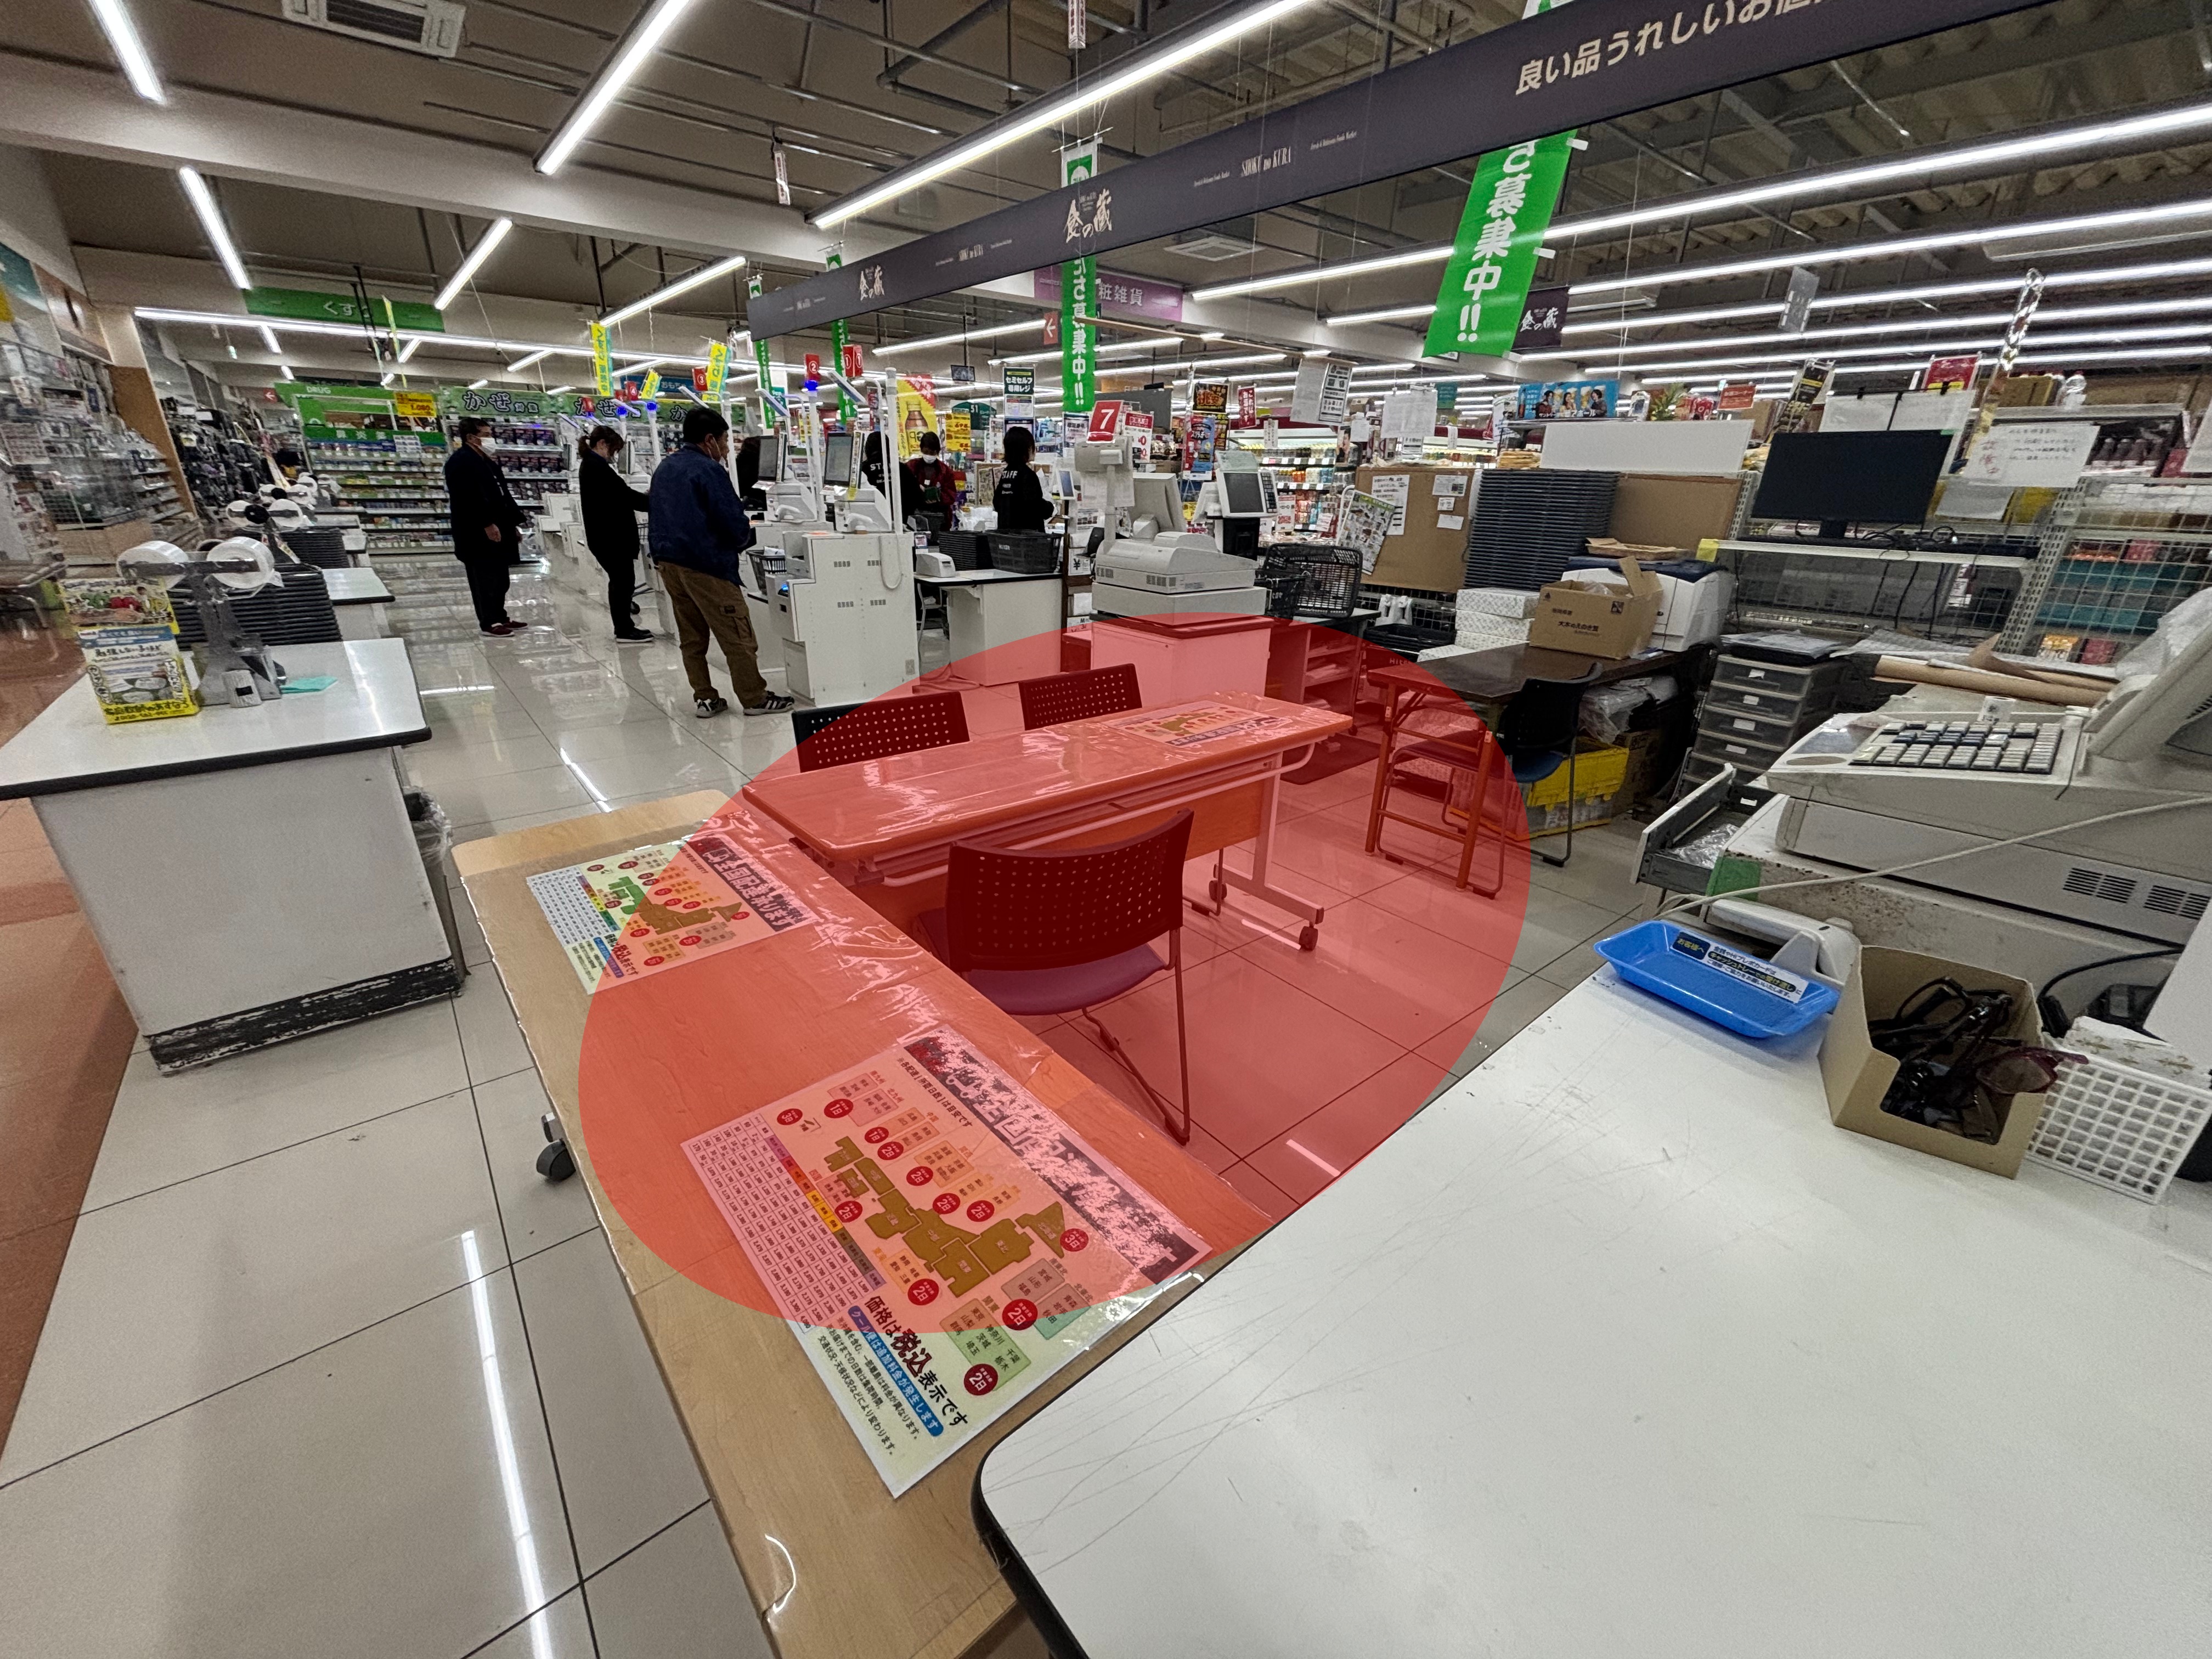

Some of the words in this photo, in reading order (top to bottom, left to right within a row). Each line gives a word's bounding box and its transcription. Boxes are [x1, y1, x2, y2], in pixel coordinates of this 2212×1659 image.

[306, 386, 331, 394] DRUG
[462, 390, 511, 412] かぜ
[1100, 409, 1115, 430] 7
[1002, 470, 1018, 479] STAFF
[712, 859, 805, 929] 全国配達承ります
[1676, 936, 1706, 955] お客様へ
[885, 1087, 905, 1103] 北九州
[828, 1103, 845, 1115] 1日
[780, 1112, 795, 1123] 3日
[867, 1131, 882, 1142] 1日
[880, 1146, 896, 1158] 2日
[910, 1170, 926, 1183] 2日
[837, 1205, 854, 1220] 2日
[935, 1198, 952, 1212] 2日
[969, 1205, 988, 1220] 2日
[1036, 1221, 1057, 1240] 北海道
[1063, 1233, 1082, 1249] 3日
[1027, 1275, 1043, 1290] 山形
[1037, 1268, 1053, 1283] 宮城
[911, 1285, 930, 1302] 2日
[1017, 1282, 1032, 1296] 福島
[1073, 1282, 1095, 1303] 北東北
[981, 1295, 1001, 1314] 関東
[1052, 1301, 1068, 1317] 岩手
[1063, 1294, 1078, 1309] 青森
[960, 1313, 975, 1329] 山梨
[969, 1306, 985, 1322] 東京
[1007, 1306, 1029, 1327] 2日
[1041, 1308, 1058, 1324] 秋田
[949, 1320, 964, 1336] 群馬
[984, 1323, 1005, 1346] 神奈川
[964, 1340, 980, 1357] 埼玉
[975, 1332, 992, 1349] 茨城
[863, 1294, 970, 1430] 価格は税込表示です
[1003, 1347, 1020, 1364] 千葉
[849, 1308, 940, 1433] クール便は追加料金が発生します
[994, 1355, 1011, 1373] 栃木
[968, 1371, 989, 1392] 2日
